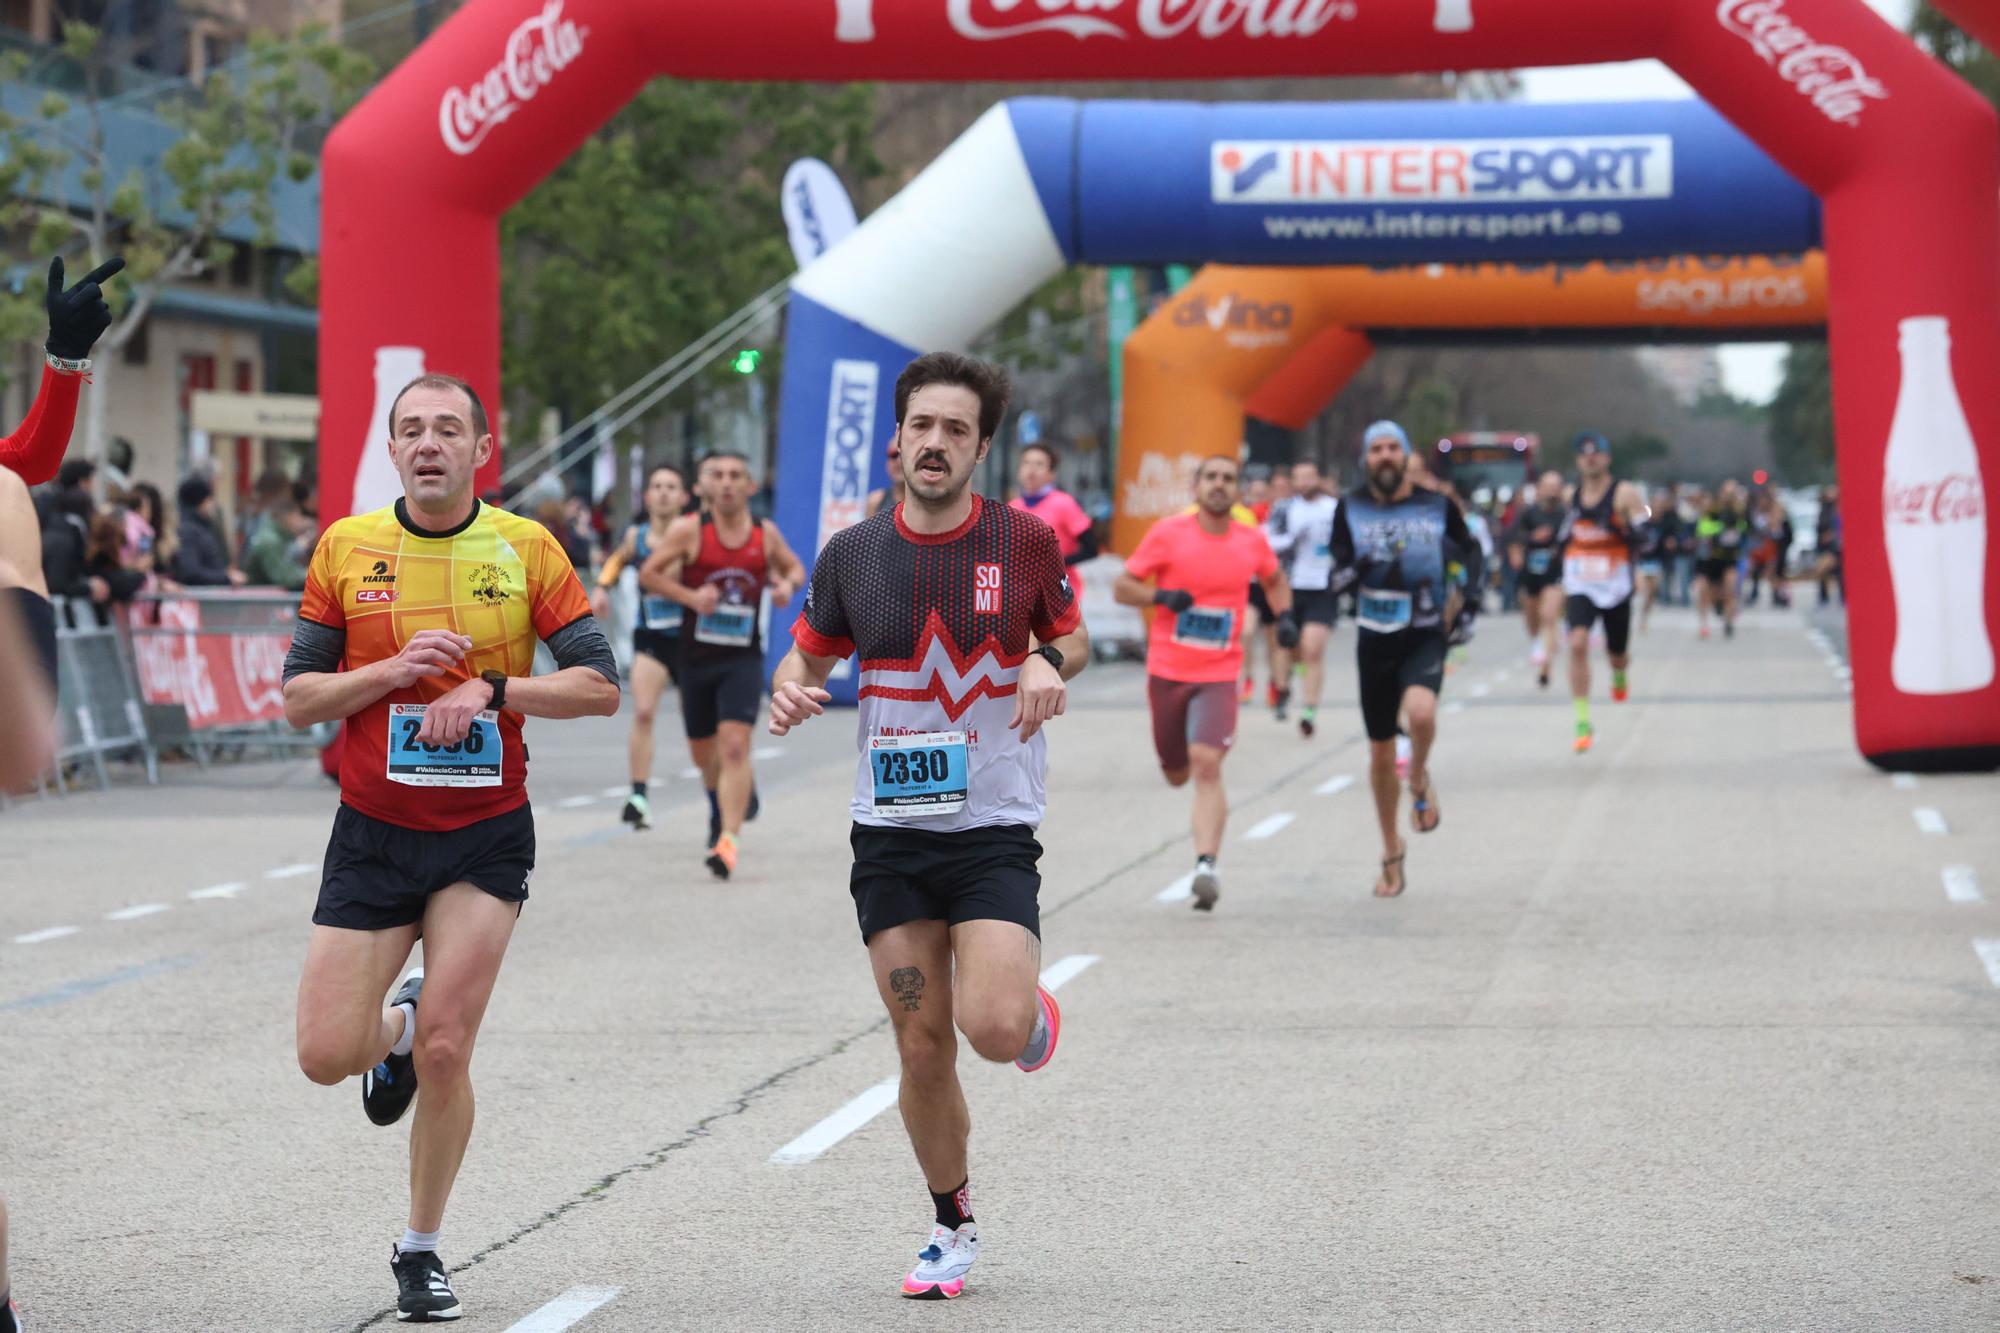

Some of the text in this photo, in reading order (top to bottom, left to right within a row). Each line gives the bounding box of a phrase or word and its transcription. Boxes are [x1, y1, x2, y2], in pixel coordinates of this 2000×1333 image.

[1291, 147, 1652, 194] INTERSPORT
[1264, 209, 1622, 240] www.intersport.es
[1637, 277, 1807, 316] seguros
[363, 575, 396, 583] VIATOR
[469, 569, 480, 583] Club
[976, 565, 1000, 588] SO
[358, 591, 390, 601] CEA
[976, 589, 991, 611] M
[403, 719, 484, 754] 26
[415, 766, 467, 775] #ValènciaCorre
[879, 749, 949, 784] 2330
